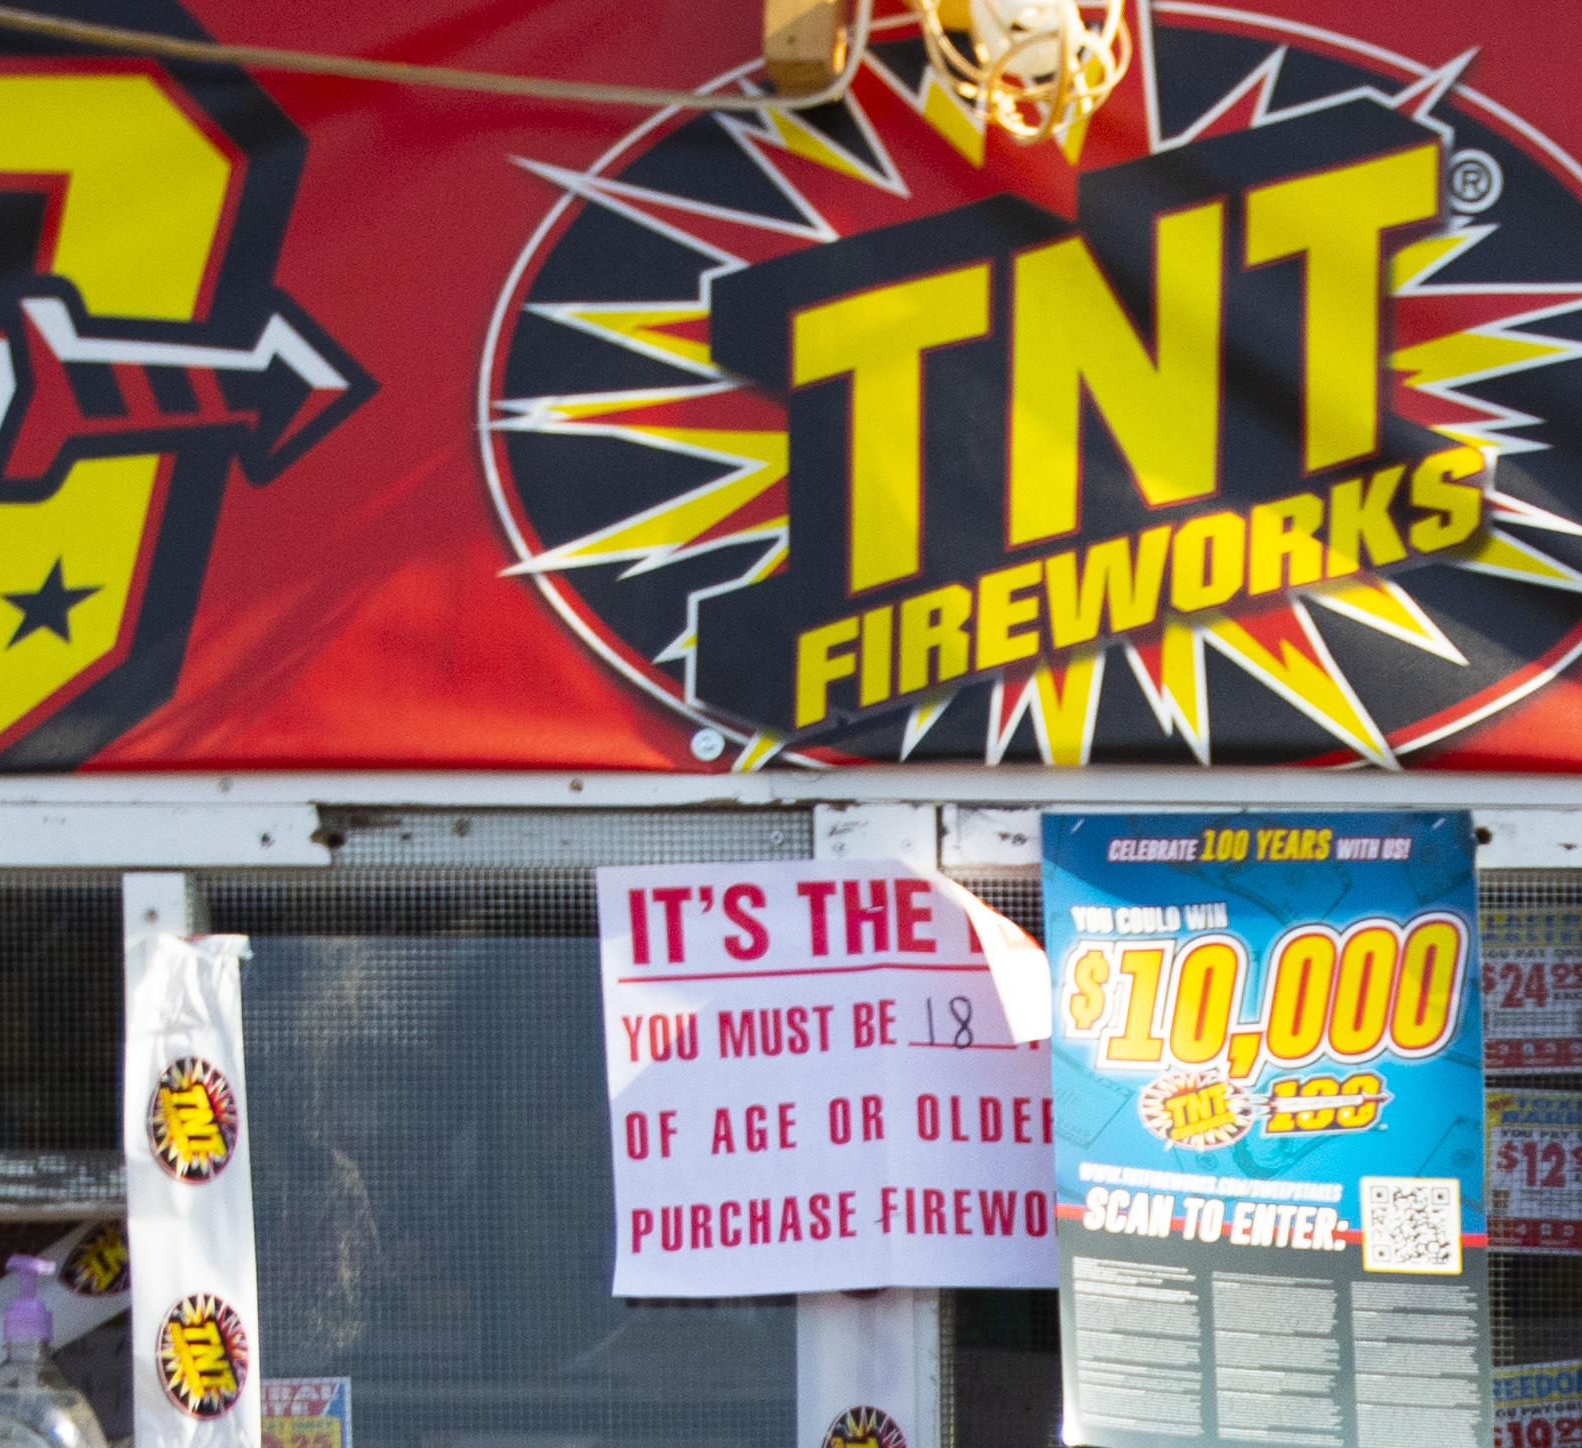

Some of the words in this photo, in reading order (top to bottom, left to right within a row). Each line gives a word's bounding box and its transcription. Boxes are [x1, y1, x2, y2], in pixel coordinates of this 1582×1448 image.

[788, 140, 1443, 598] TNT
[792, 442, 1485, 731] FIREWORKS
[1108, 839, 1196, 862] CELEBRATE
[1200, 830, 1250, 861] 100
[1255, 828, 1330, 861] YEARS
[1337, 837, 1381, 861] WITH
[1384, 836, 1411, 860] US!
[626, 882, 771, 967] IT'S
[797, 878, 938, 957] THE
[1071, 905, 1115, 933] YOU
[1115, 905, 1181, 934] COULD
[1184, 903, 1229, 931] WIN
[924, 995, 975, 1050] 18
[1066, 912, 1469, 1083] $10,000
[622, 1013, 699, 1063] YOU
[718, 1004, 834, 1059] MUST
[852, 999, 898, 1049] BE
[625, 1110, 679, 1161] OF
[711, 1102, 798, 1156] AGE
[829, 1094, 885, 1145] OR
[1165, 1083, 1230, 1127] TNT
[631, 1191, 857, 1255] PURCHASE
[881, 1186, 1055, 1238] FIREWO
[1082, 1186, 1175, 1239] SCAN
[1183, 1196, 1226, 1243] TO
[1229, 1200, 1350, 1252] ENTER:
